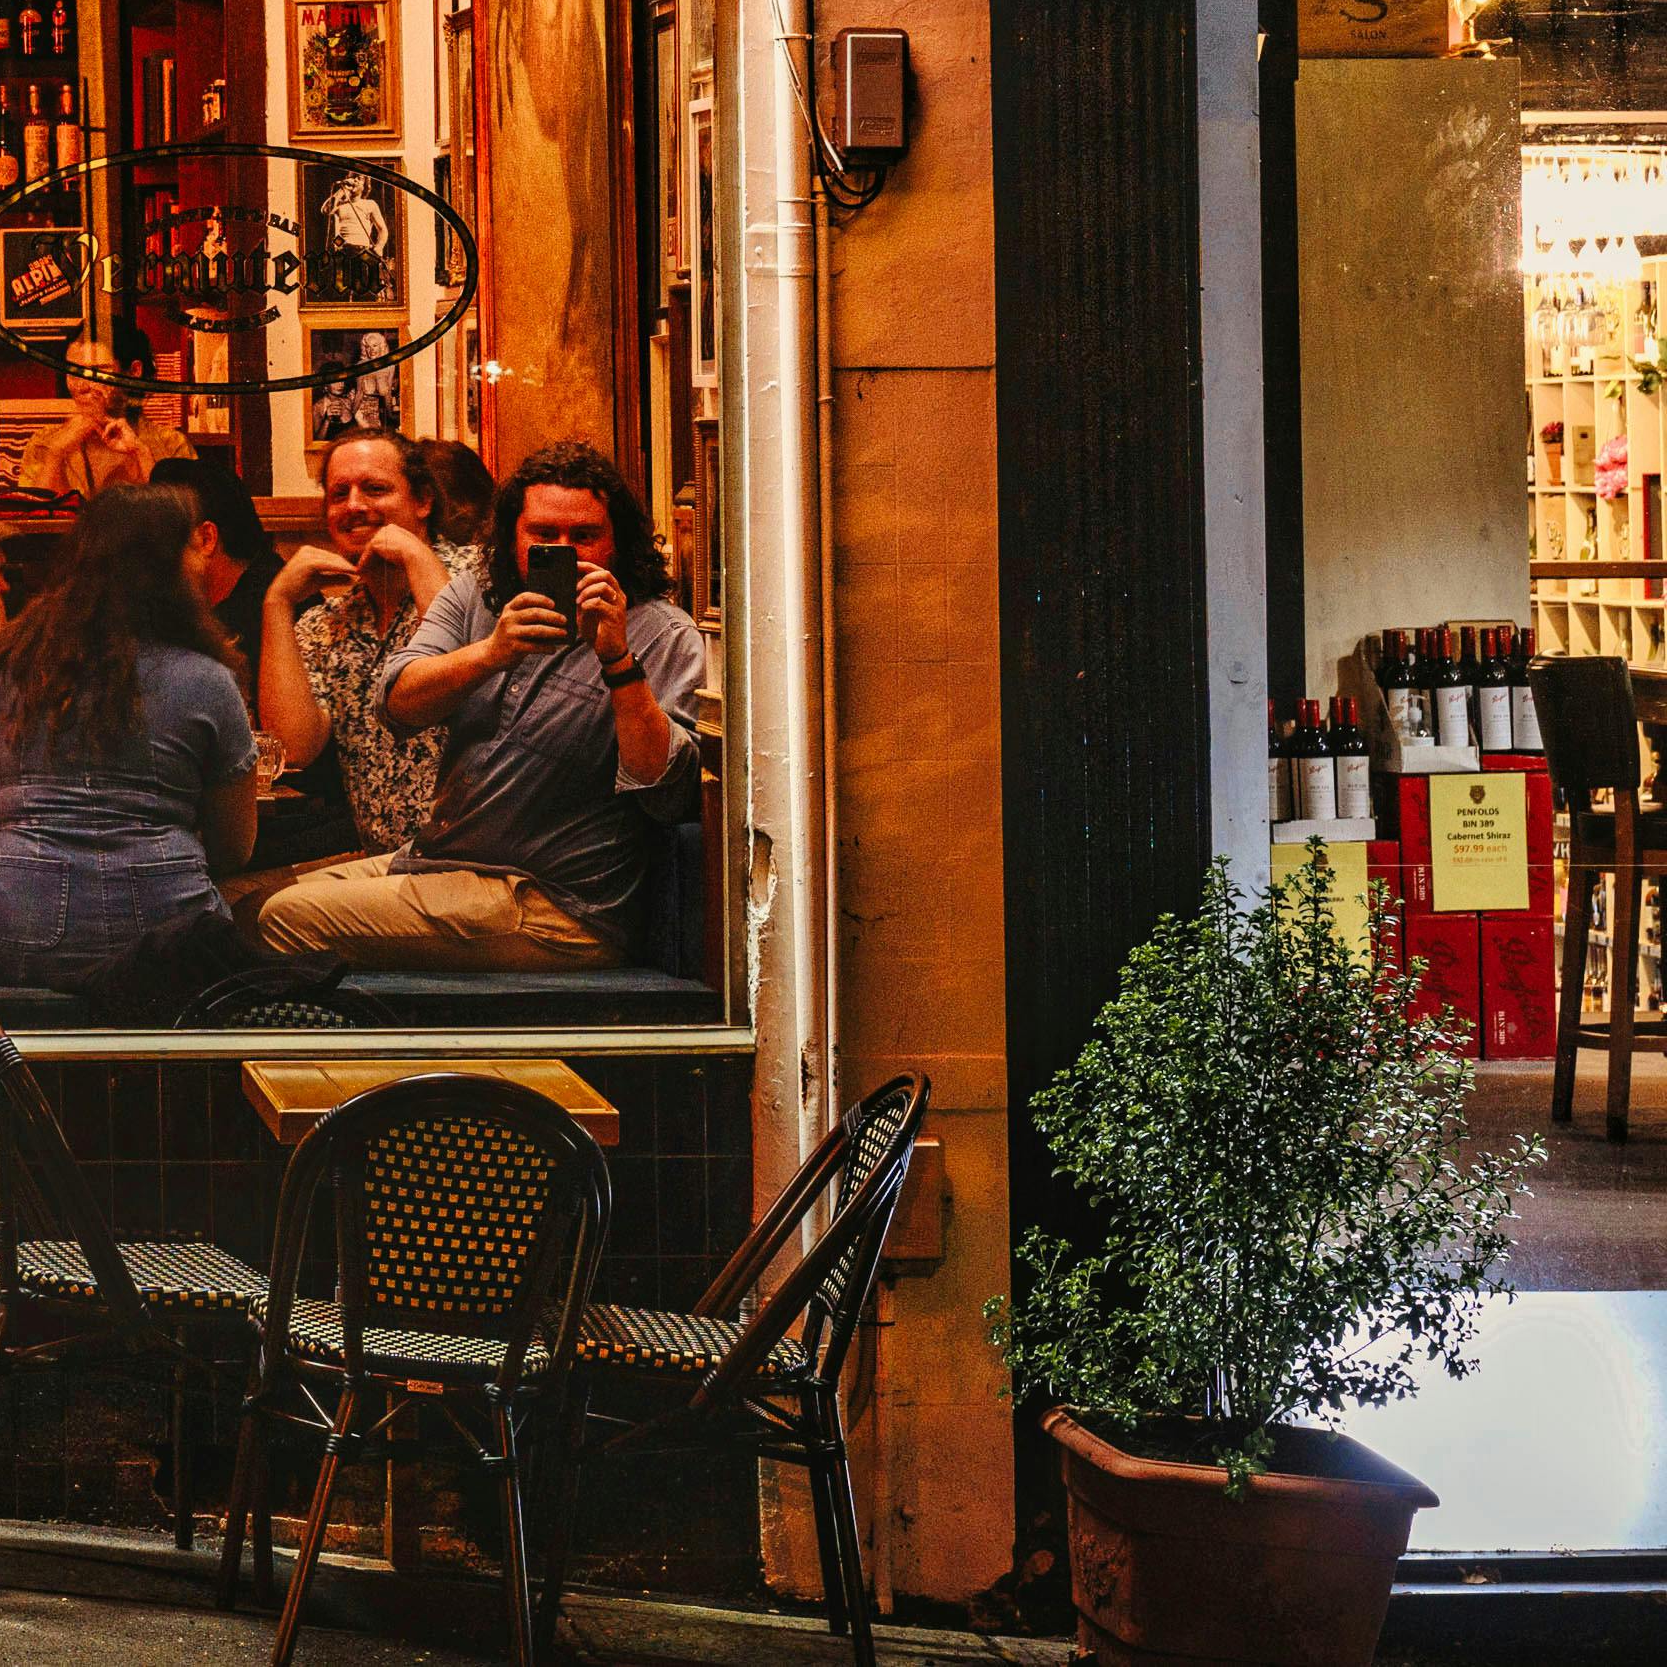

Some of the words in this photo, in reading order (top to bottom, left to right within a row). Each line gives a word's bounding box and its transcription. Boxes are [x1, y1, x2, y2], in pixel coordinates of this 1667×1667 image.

[301, 8, 378, 26] MARTINI
[1351, 30, 1387, 40] SALON
[1463, 820, 1477, 828] BIN
[1479, 820, 1495, 828] 389
[1447, 832, 1484, 841] Cabernet
[1486, 831, 1511, 840] Shiraz
[1454, 845, 1484, 854] $97.99
[1487, 844, 1508, 852] each
